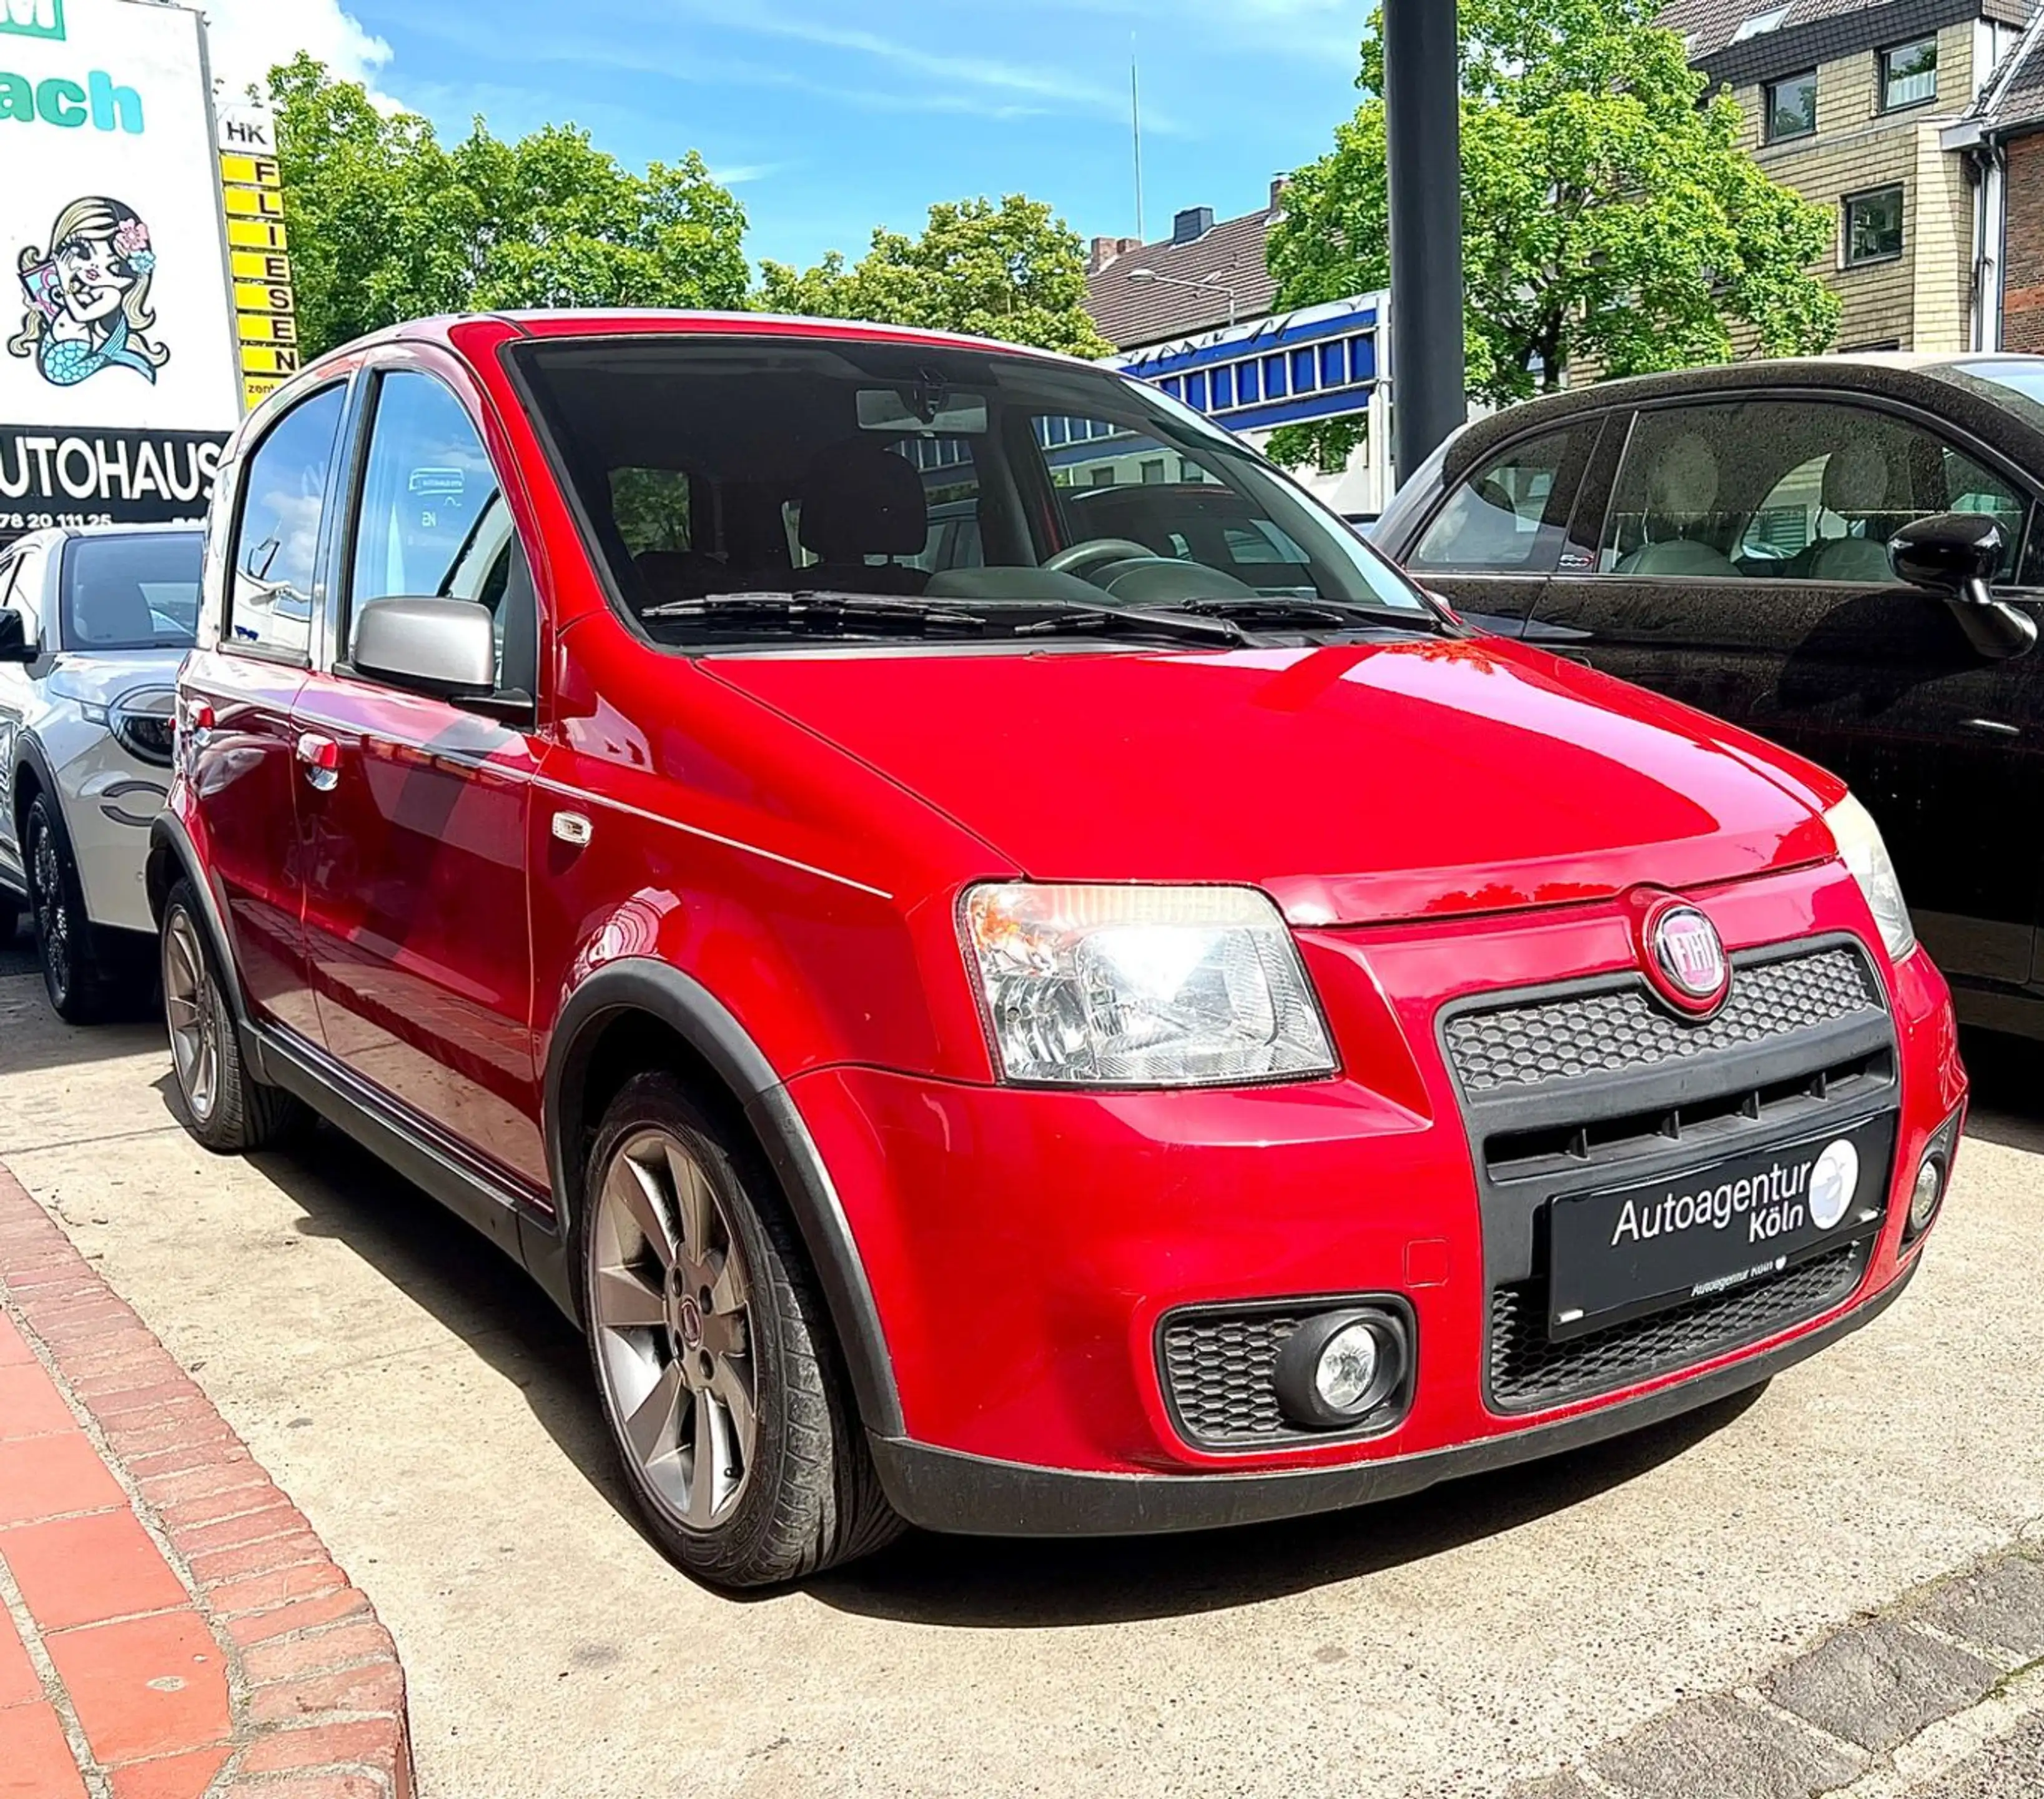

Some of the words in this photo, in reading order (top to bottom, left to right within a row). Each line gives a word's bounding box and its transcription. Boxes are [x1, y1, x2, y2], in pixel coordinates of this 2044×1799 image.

[227, 121, 267, 145] HK
[255, 162, 296, 371] FLIESEN
[27, 514, 53, 528] 20
[1611, 1161, 1810, 1246] Autoagentur
[1749, 1201, 1804, 1243] Köln
